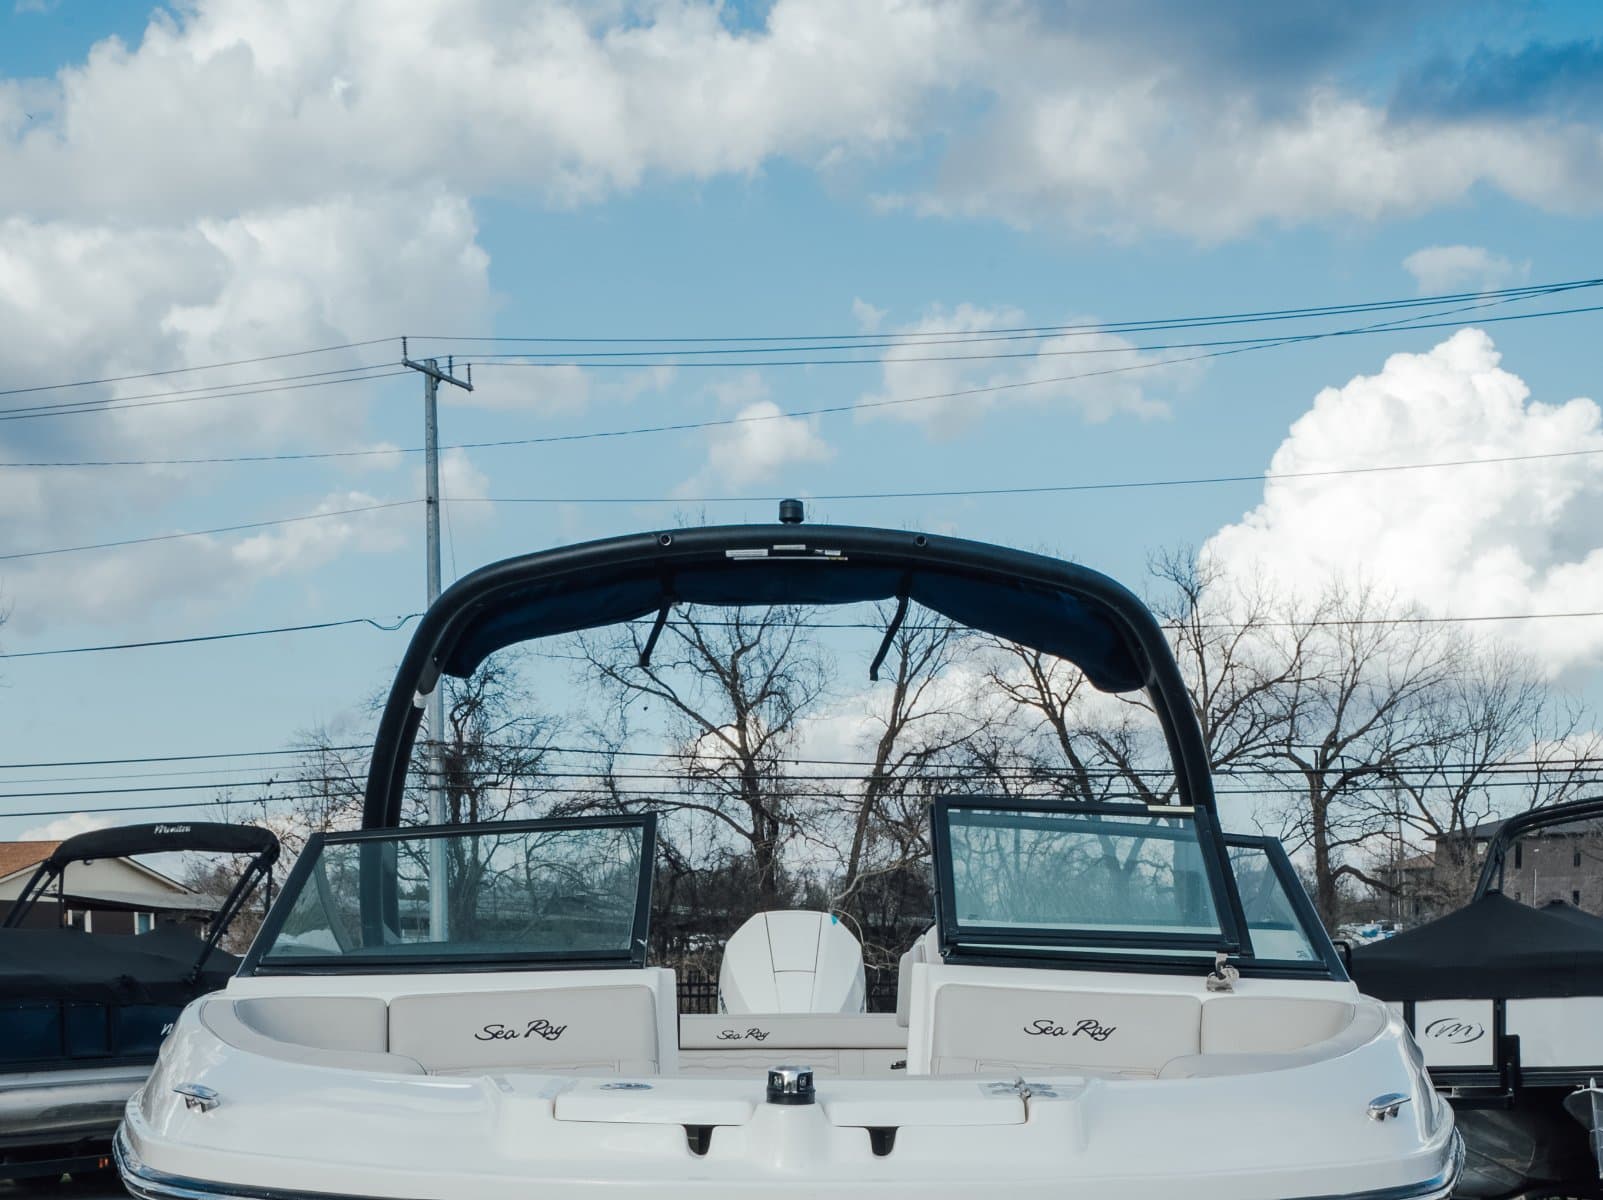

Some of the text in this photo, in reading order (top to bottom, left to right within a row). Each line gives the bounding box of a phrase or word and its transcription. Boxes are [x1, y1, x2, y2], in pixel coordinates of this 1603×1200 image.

[474, 1019, 567, 1040] Sea Ray
[716, 1027, 770, 1041] Sea Ray
[1023, 1019, 1116, 1041] Sea Ray
